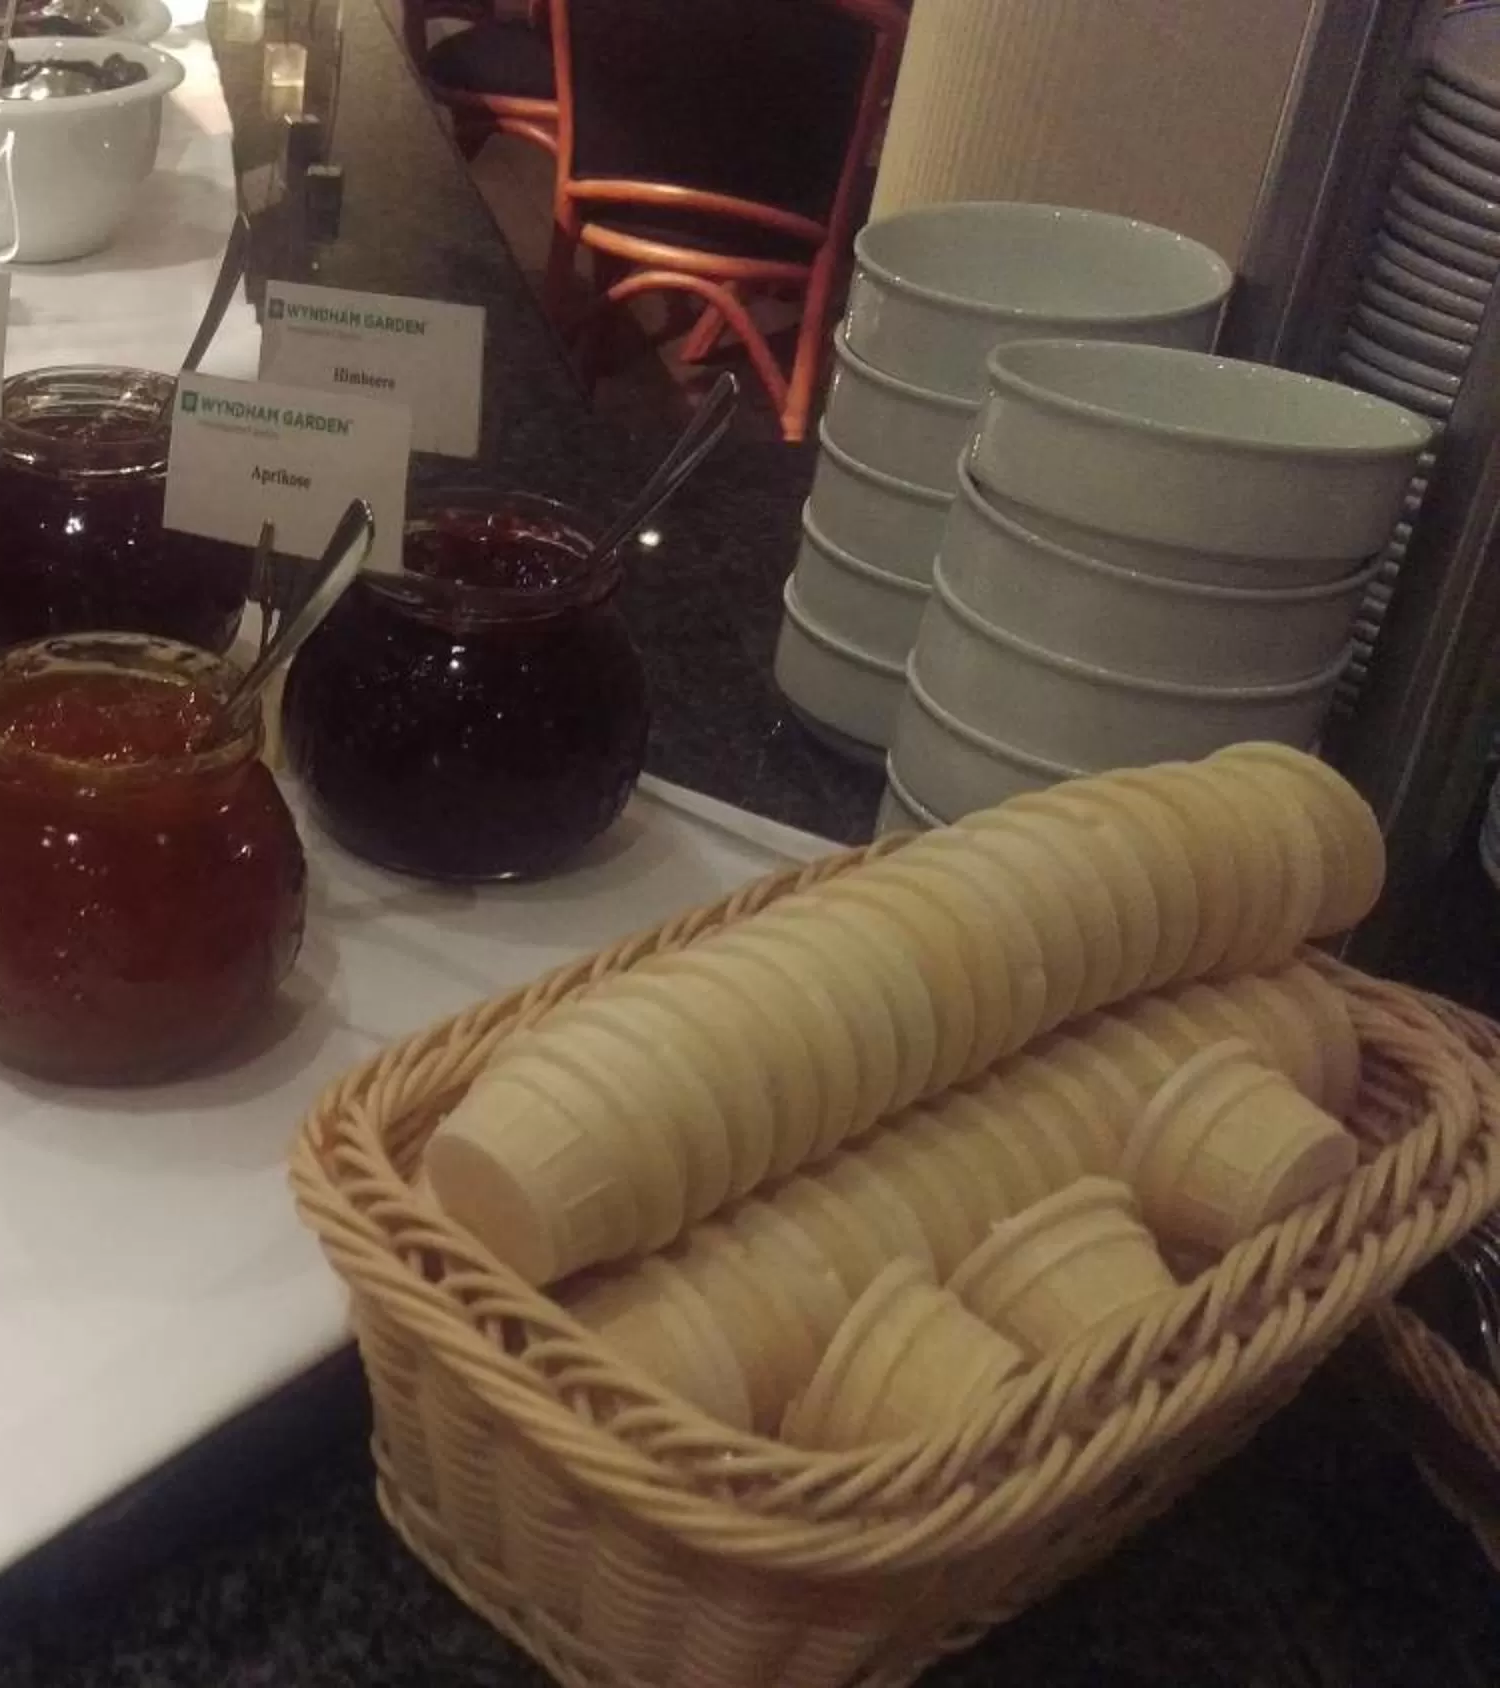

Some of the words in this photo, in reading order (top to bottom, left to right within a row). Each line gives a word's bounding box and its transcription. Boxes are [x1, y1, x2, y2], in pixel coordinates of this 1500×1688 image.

[286, 302, 362, 328] WYNDHAM
[363, 315, 426, 336] GARDEN
[332, 366, 397, 390] Himbeere
[200, 395, 280, 423] WYNDHAM
[282, 412, 350, 435] GARDEN
[251, 464, 312, 490] Aprikose
